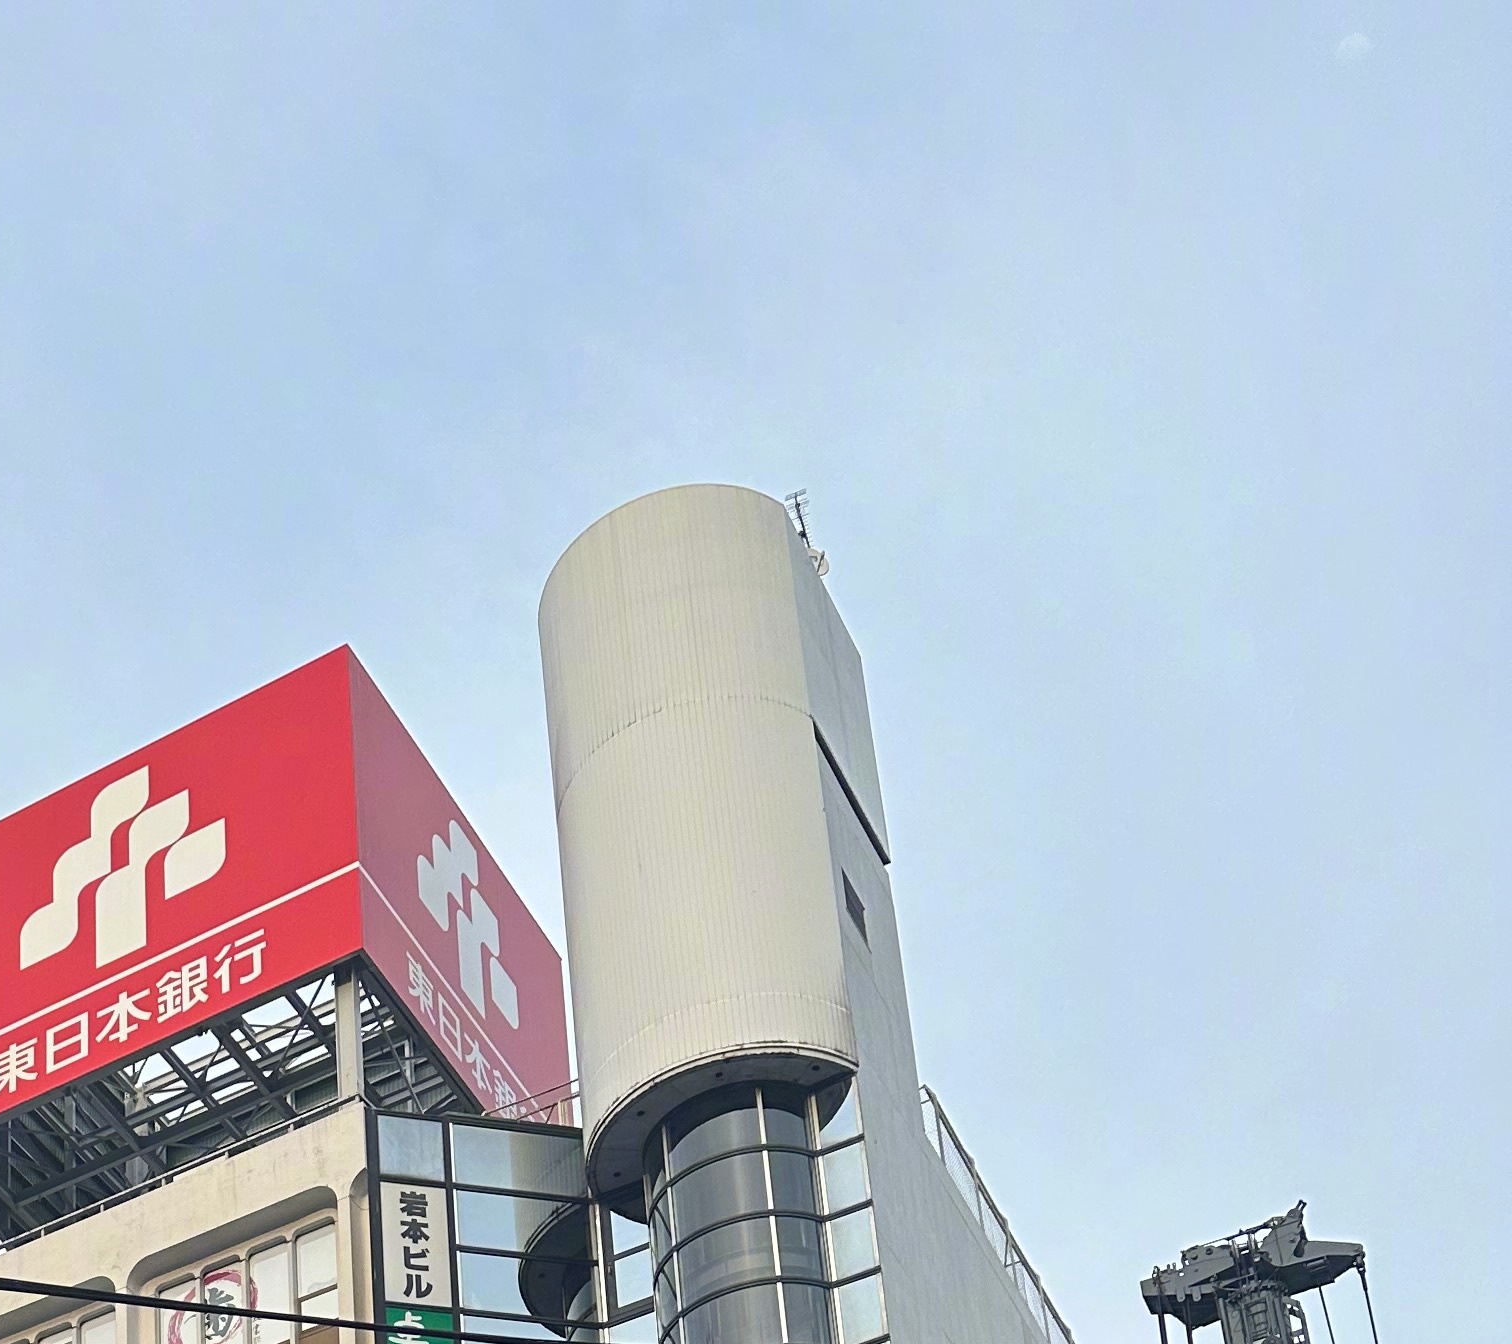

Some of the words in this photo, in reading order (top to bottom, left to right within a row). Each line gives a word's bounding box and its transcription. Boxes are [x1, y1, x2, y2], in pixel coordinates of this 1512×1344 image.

[406, 950, 535, 1122] 東日本銀
[398, 1190, 434, 1300] 岩本ビル
